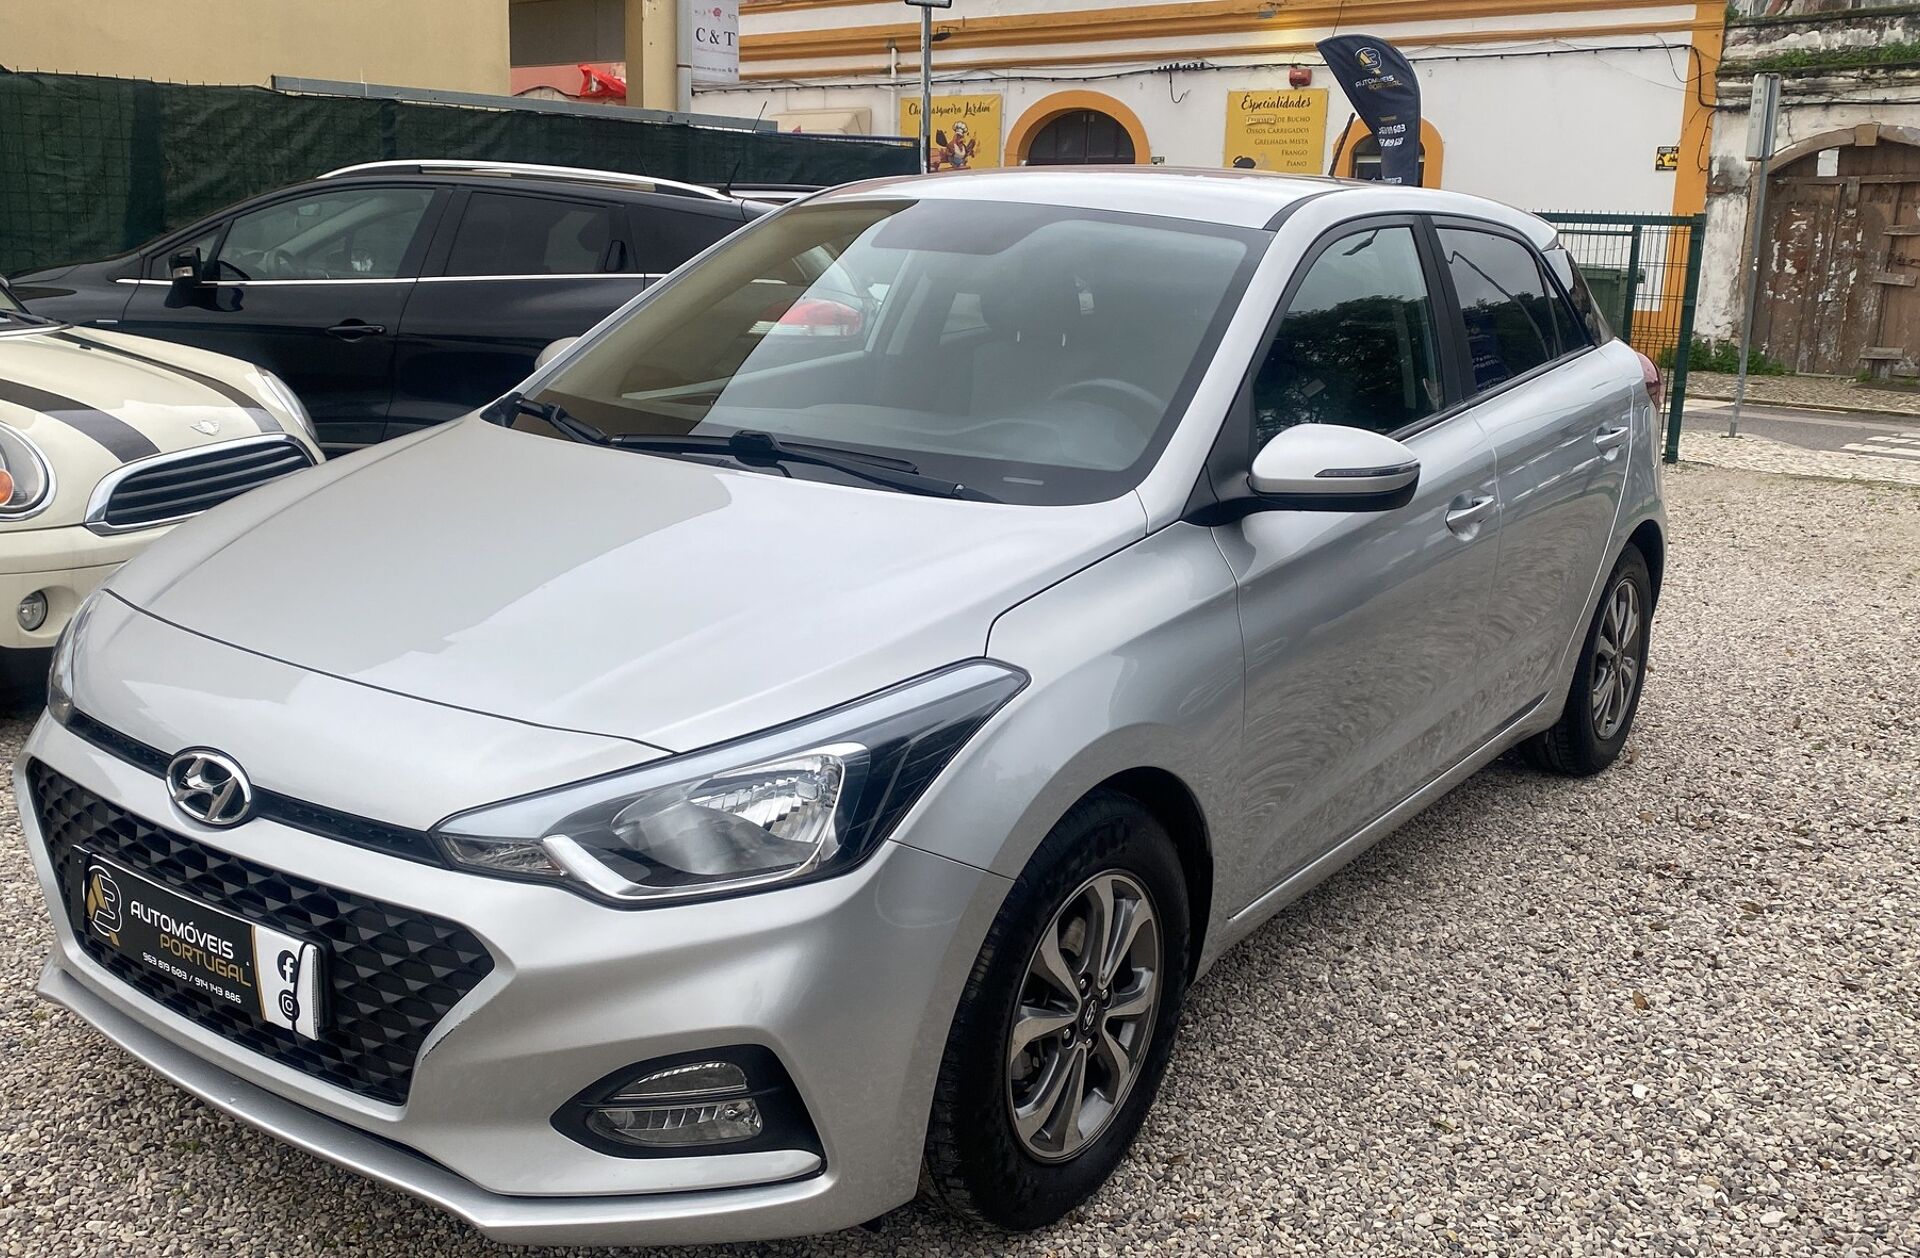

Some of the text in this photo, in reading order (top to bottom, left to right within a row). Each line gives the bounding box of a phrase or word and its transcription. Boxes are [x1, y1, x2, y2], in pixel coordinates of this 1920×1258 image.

[695, 27, 735, 46] C & T
[963, 101, 990, 118] Jardim
[1241, 92, 1311, 112] Especialidades
[130, 900, 234, 960] AUTOMÓVEIS
[142, 951, 157, 966] 963
[158, 960, 170, 972] 819
[171, 966, 187, 980] 603
[194, 977, 209, 990] 914
[209, 983, 223, 996] 143
[225, 990, 241, 1004] 886
[160, 933, 252, 987] PORTUGAL
